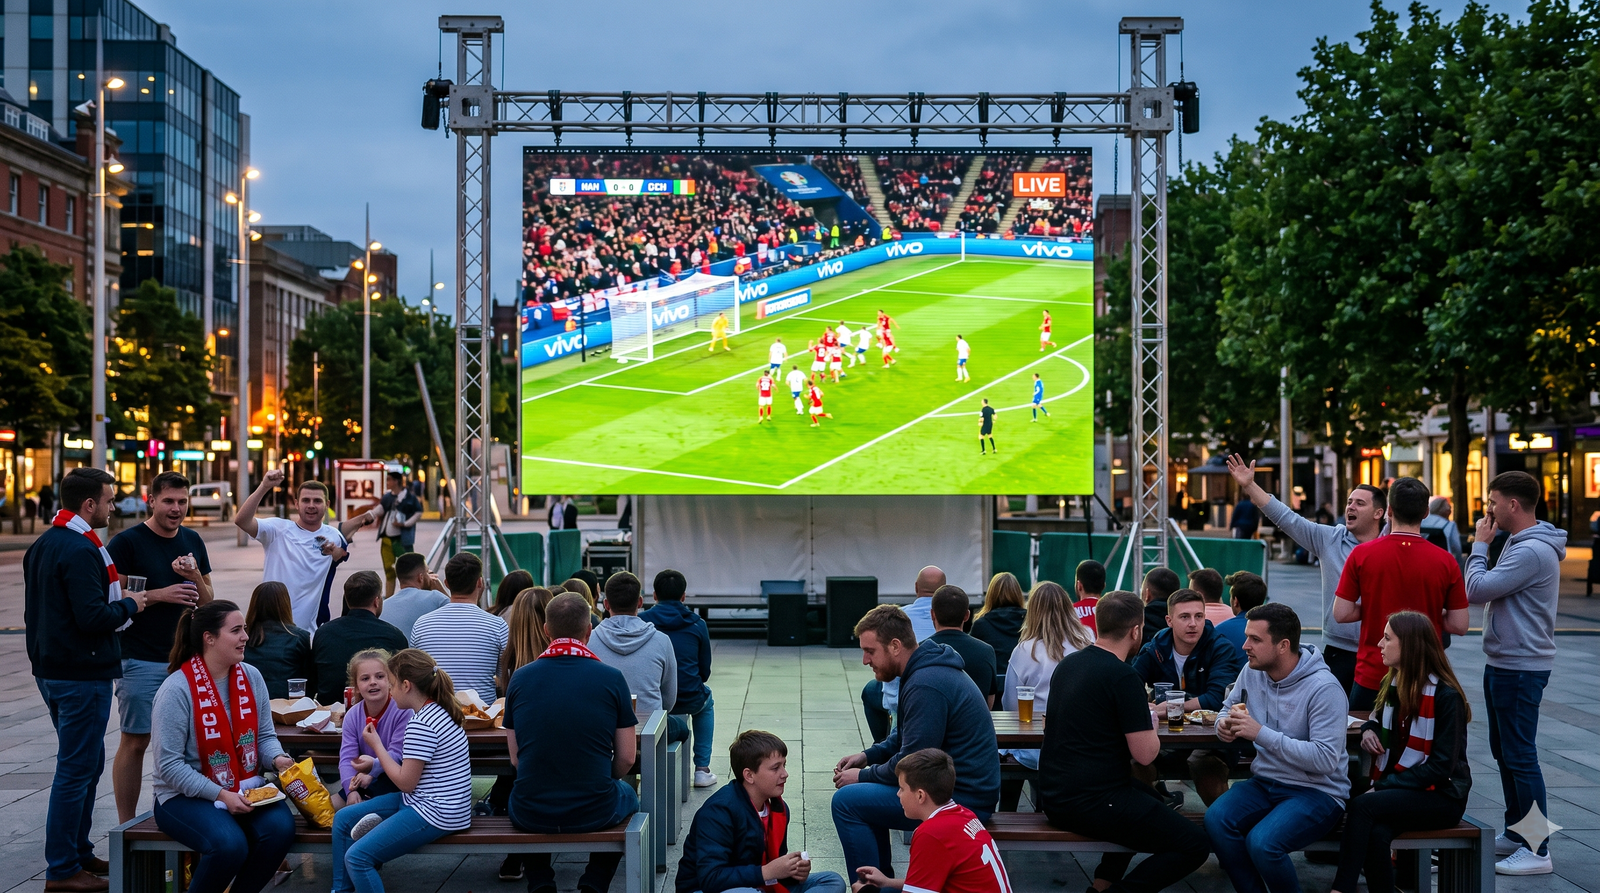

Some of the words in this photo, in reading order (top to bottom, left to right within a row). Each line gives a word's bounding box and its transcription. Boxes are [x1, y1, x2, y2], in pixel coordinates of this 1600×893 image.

[1018, 177, 1061, 193] LIVE
[885, 241, 924, 257] vivo
[1021, 241, 1073, 258] vivo
[817, 260, 844, 278] vivo
[739, 282, 768, 302] vivo
[653, 304, 690, 326] vivo
[543, 334, 588, 358] vivo
[202, 712, 221, 741] FC
